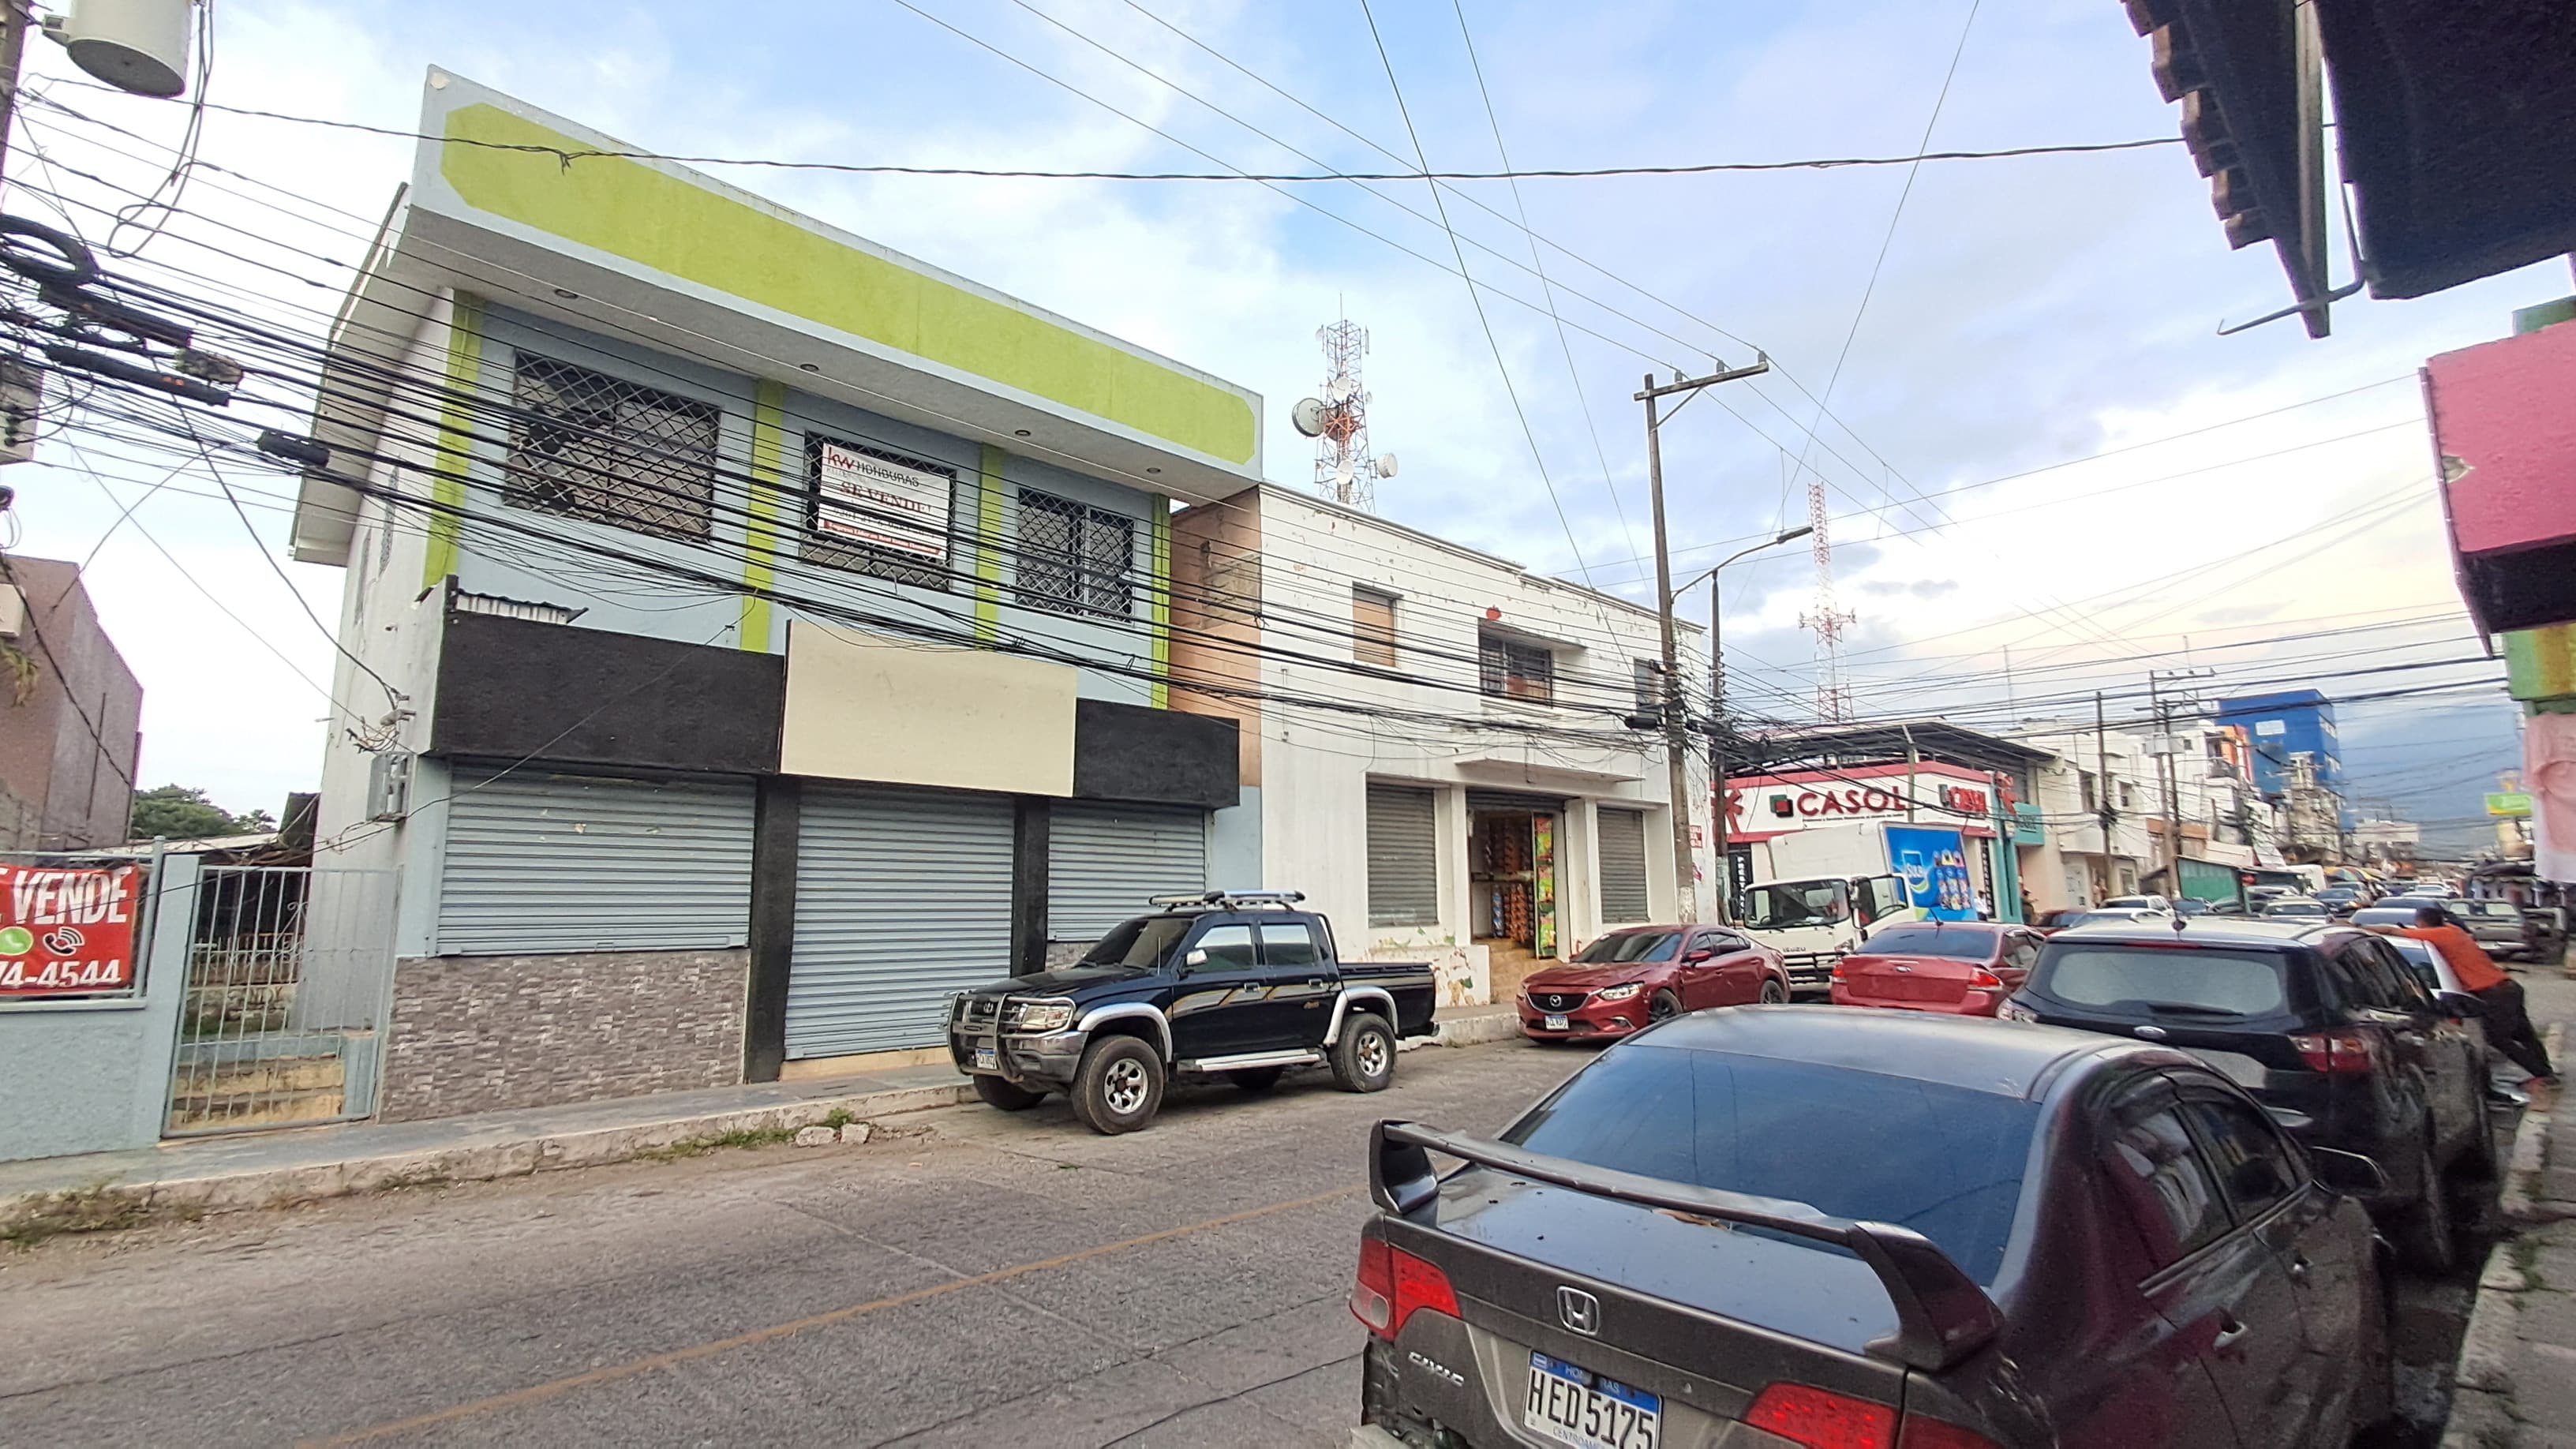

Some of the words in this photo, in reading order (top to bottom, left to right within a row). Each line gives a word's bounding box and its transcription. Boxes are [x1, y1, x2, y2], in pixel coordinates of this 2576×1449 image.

[857, 462, 919, 488] HONDURAS
[1797, 786, 1907, 816] CASOL
[13, 865, 132, 924] VENDE
[1408, 1351, 1465, 1387] CIVIC
[1565, 1364, 1620, 1395] HONRAS
[1528, 1369, 1580, 1429] HED
[1585, 1391, 1654, 1449] 5175
